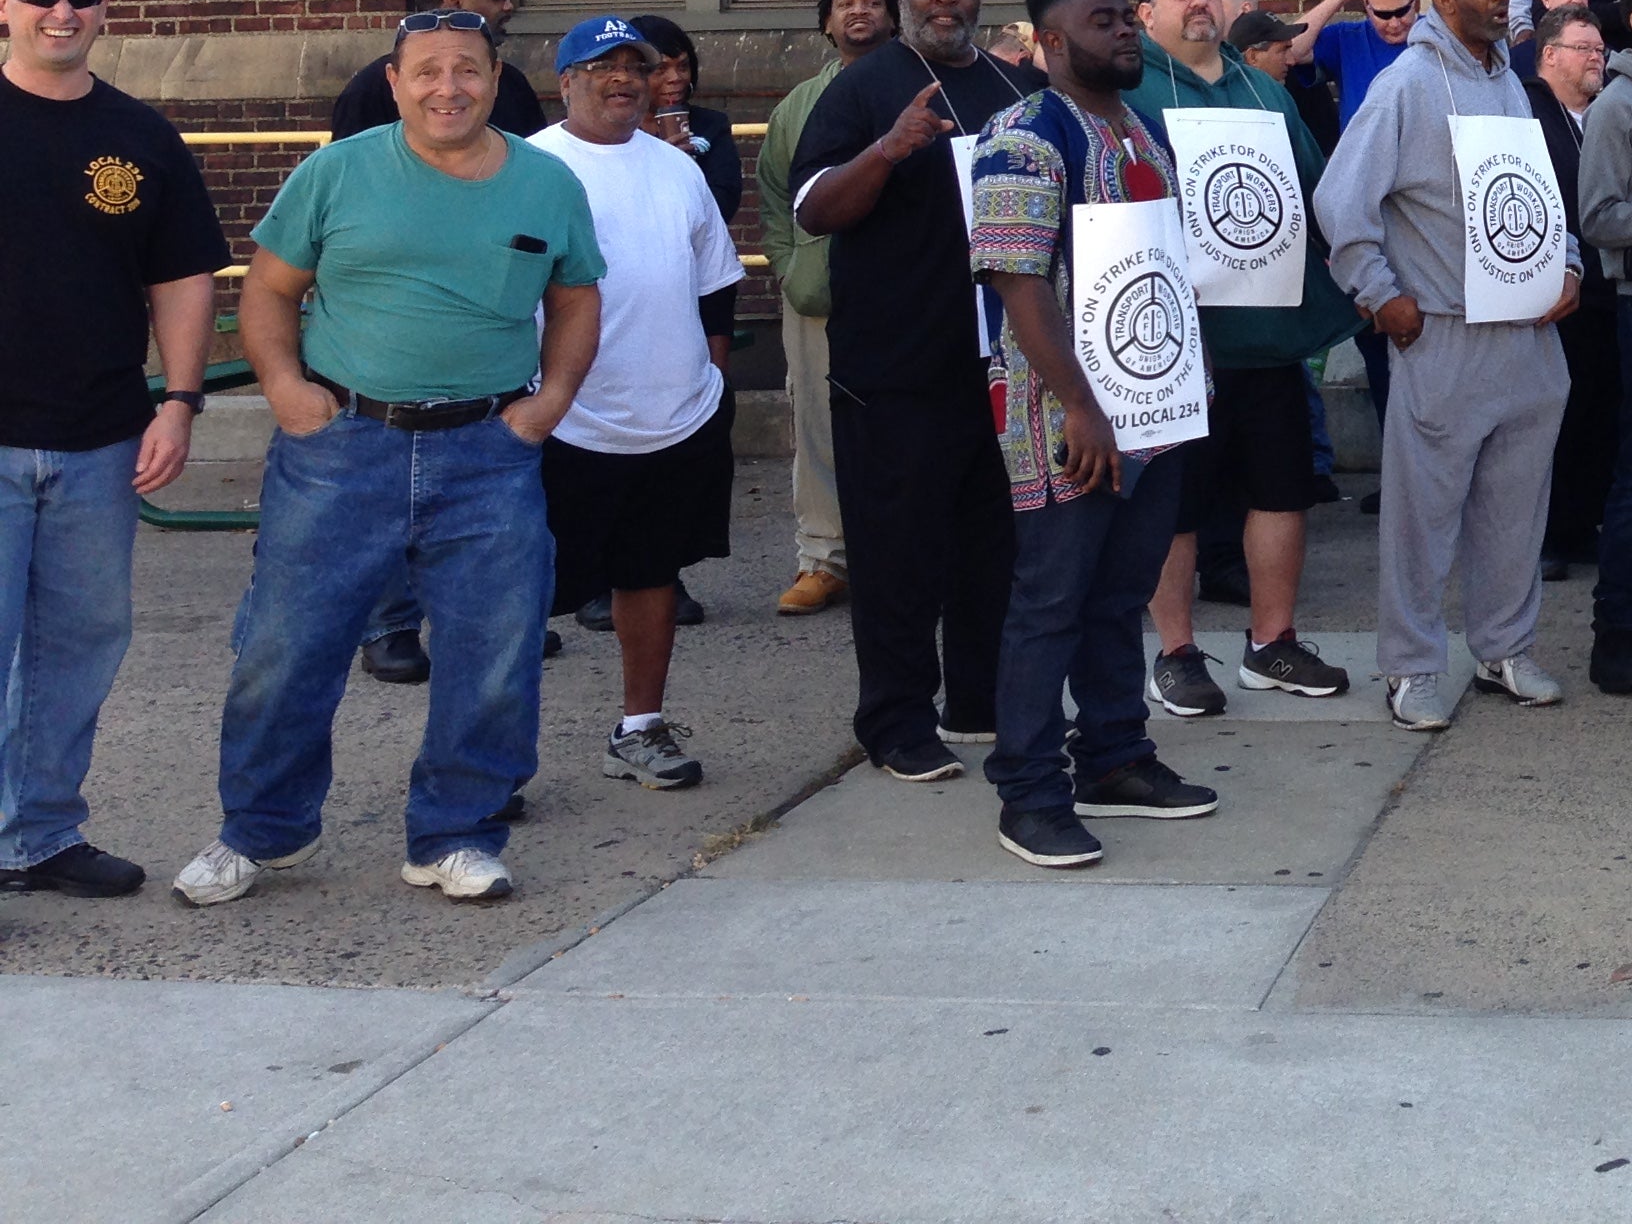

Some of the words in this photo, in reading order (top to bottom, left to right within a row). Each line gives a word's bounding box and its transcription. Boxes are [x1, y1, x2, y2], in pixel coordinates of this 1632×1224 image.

[84, 156, 121, 175] LOCAL
[125, 161, 144, 181] 234
[1190, 145, 1228, 176] STRIKE
[1230, 144, 1255, 158] FOR
[1186, 178, 1197, 198] ON
[1213, 170, 1236, 213] TRANSPORT
[1246, 172, 1277, 213] WORKERS
[1258, 153, 1298, 201] DIGNITY
[1467, 190, 1477, 212] ON
[1473, 154, 1501, 189] STRIKE
[1501, 153, 1522, 168] FOR
[1524, 162, 1561, 211] DIGNITY
[85, 193, 125, 215] CONTRACT
[1490, 180, 1509, 228] TRANSPORT
[1516, 183, 1544, 225] WORKERS
[1186, 209, 1203, 238] AND
[1200, 240, 1247, 271] JUSTICE
[1250, 256, 1268, 270] ON
[1270, 238, 1291, 261] THE
[1291, 212, 1302, 240] JOB
[1468, 225, 1482, 254] AND
[1478, 255, 1517, 285] JUSTICE
[1519, 268, 1534, 284] ON
[1534, 250, 1554, 273] THE
[1554, 223, 1563, 250] JOB
[1082, 297, 1099, 324] ON
[1094, 251, 1145, 294] STRIKE
[1148, 247, 1167, 263] FOR
[1166, 257, 1195, 310] DIGNITY
[1115, 282, 1149, 341] TRANSPORT
[1080, 339, 1101, 373] AND
[1097, 374, 1153, 405] JUSTICE
[1156, 383, 1174, 402] ON
[1174, 362, 1193, 387] THE
[1189, 326, 1198, 358] JOB
[1131, 408, 1177, 428] LOCAL
[1178, 401, 1200, 419] 234
